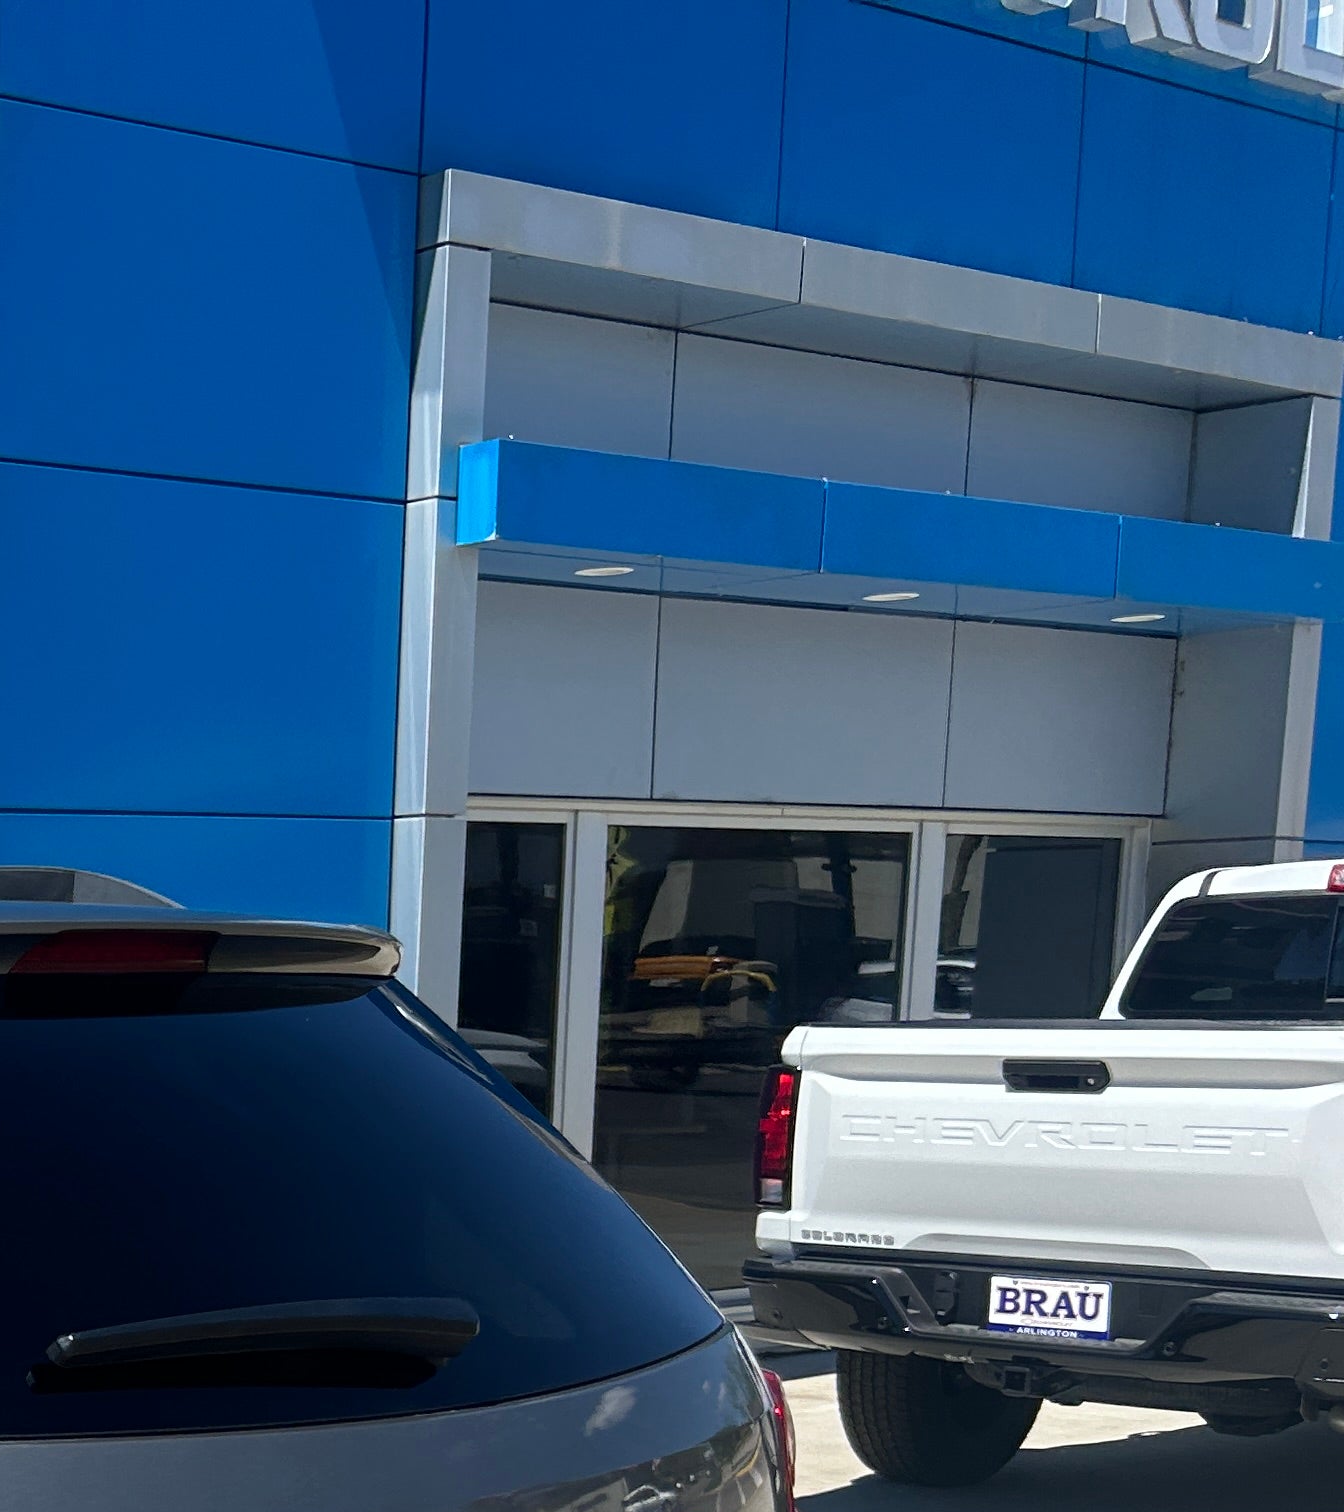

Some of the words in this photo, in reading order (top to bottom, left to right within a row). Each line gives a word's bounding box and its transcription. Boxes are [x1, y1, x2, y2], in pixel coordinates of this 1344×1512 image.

[838, 1113, 1290, 1156] CHEVROLET
[995, 1286, 1104, 1320] BRAU
[1016, 1326, 1078, 1338] ARLINGTON
